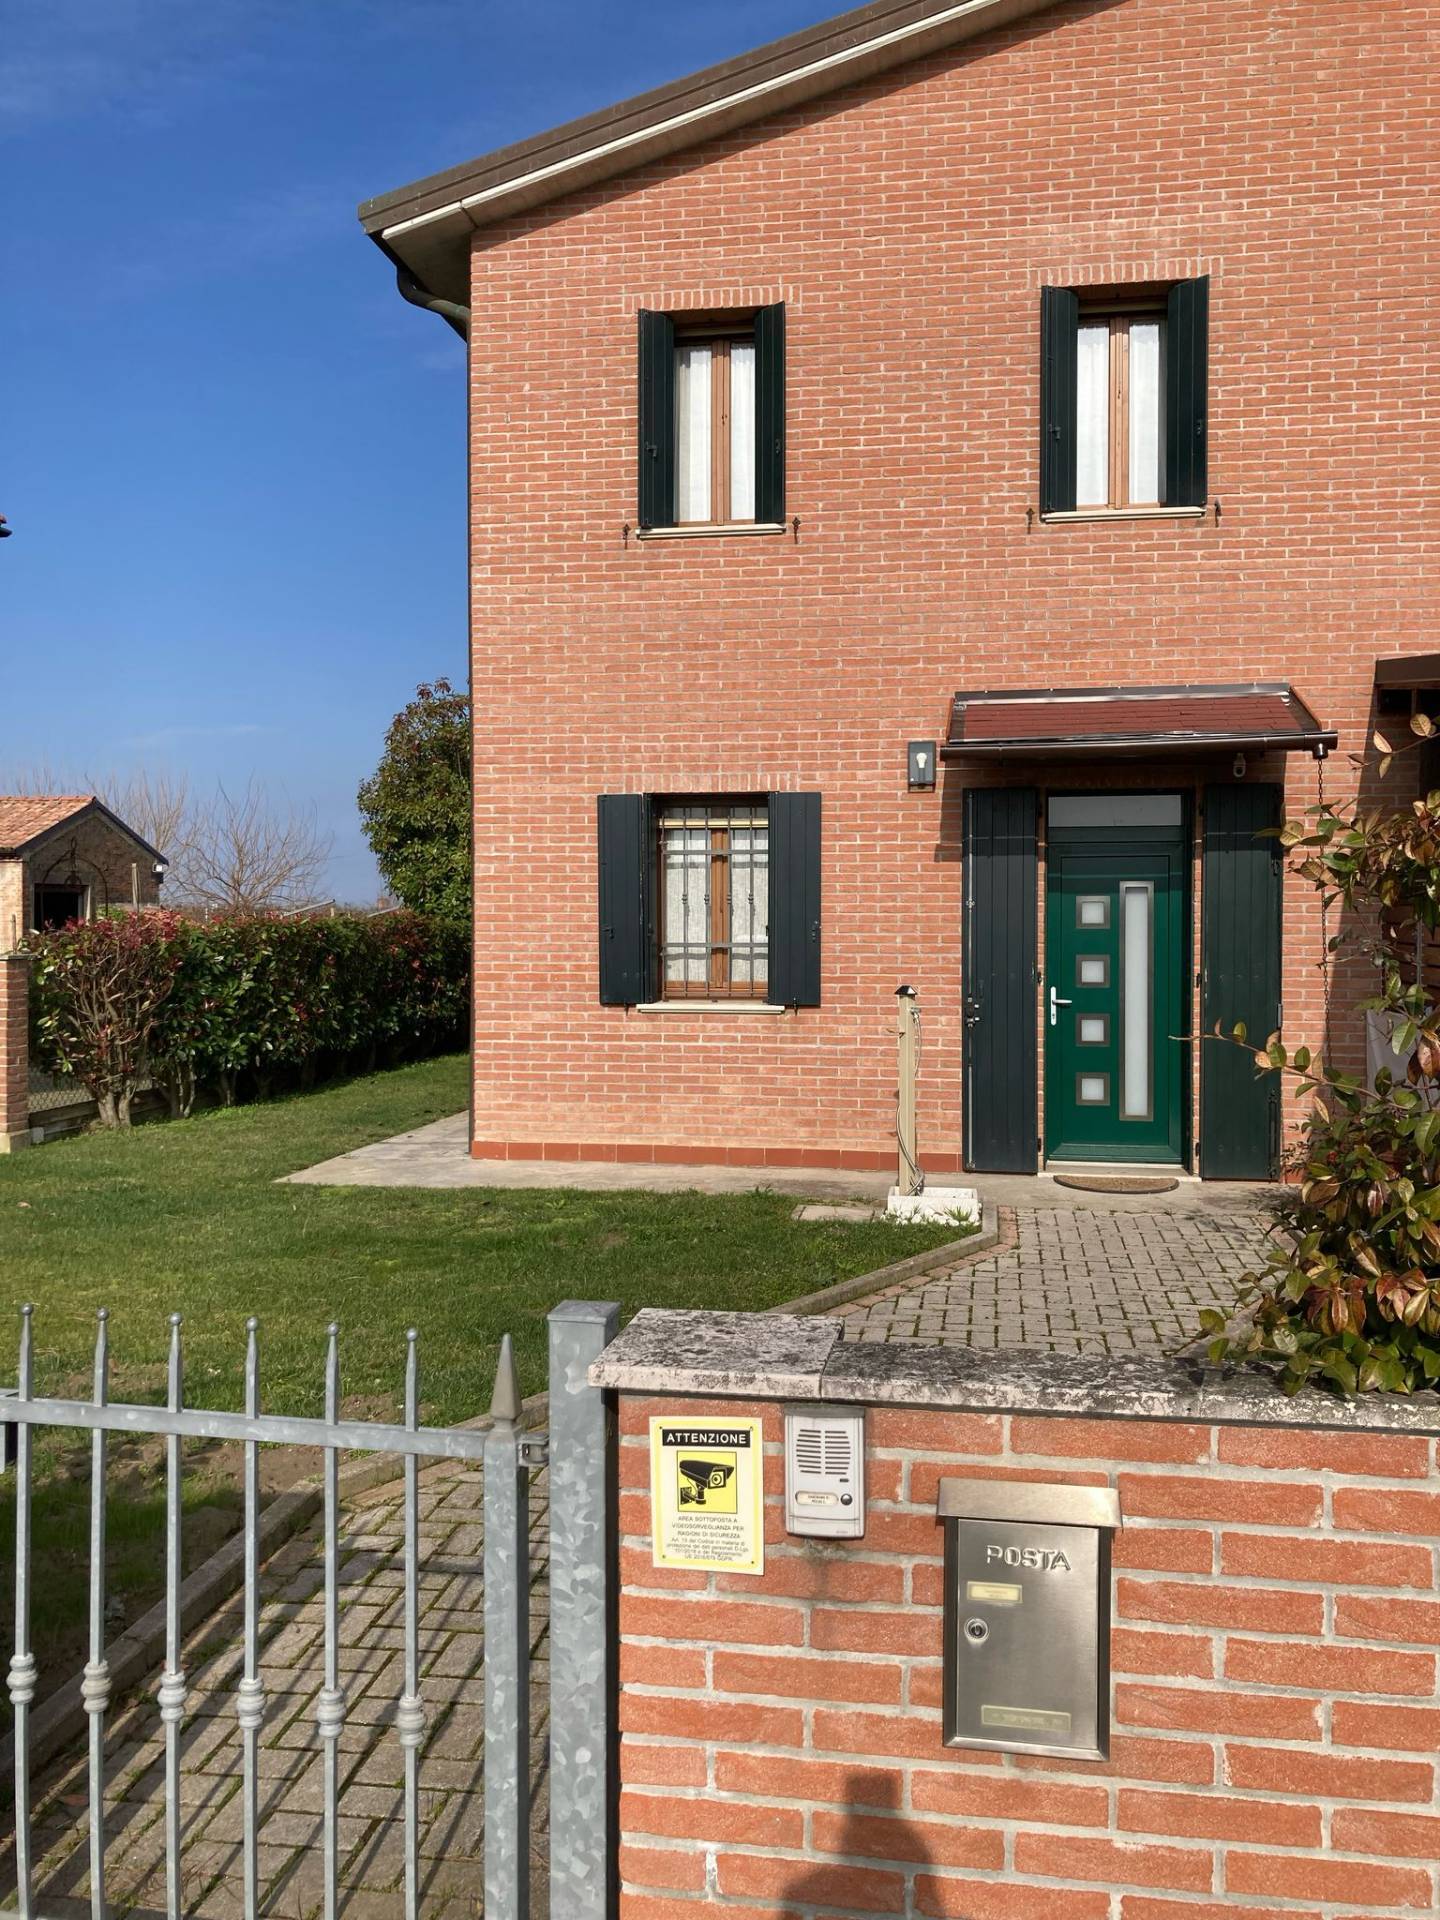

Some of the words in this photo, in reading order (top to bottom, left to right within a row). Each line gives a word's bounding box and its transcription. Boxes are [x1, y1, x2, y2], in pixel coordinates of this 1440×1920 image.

[666, 1432, 746, 1444] ATTENZIONE
[672, 1522, 732, 1530] VIDEOSORVEGLIANZA
[986, 1544, 1072, 1571] POSTA
